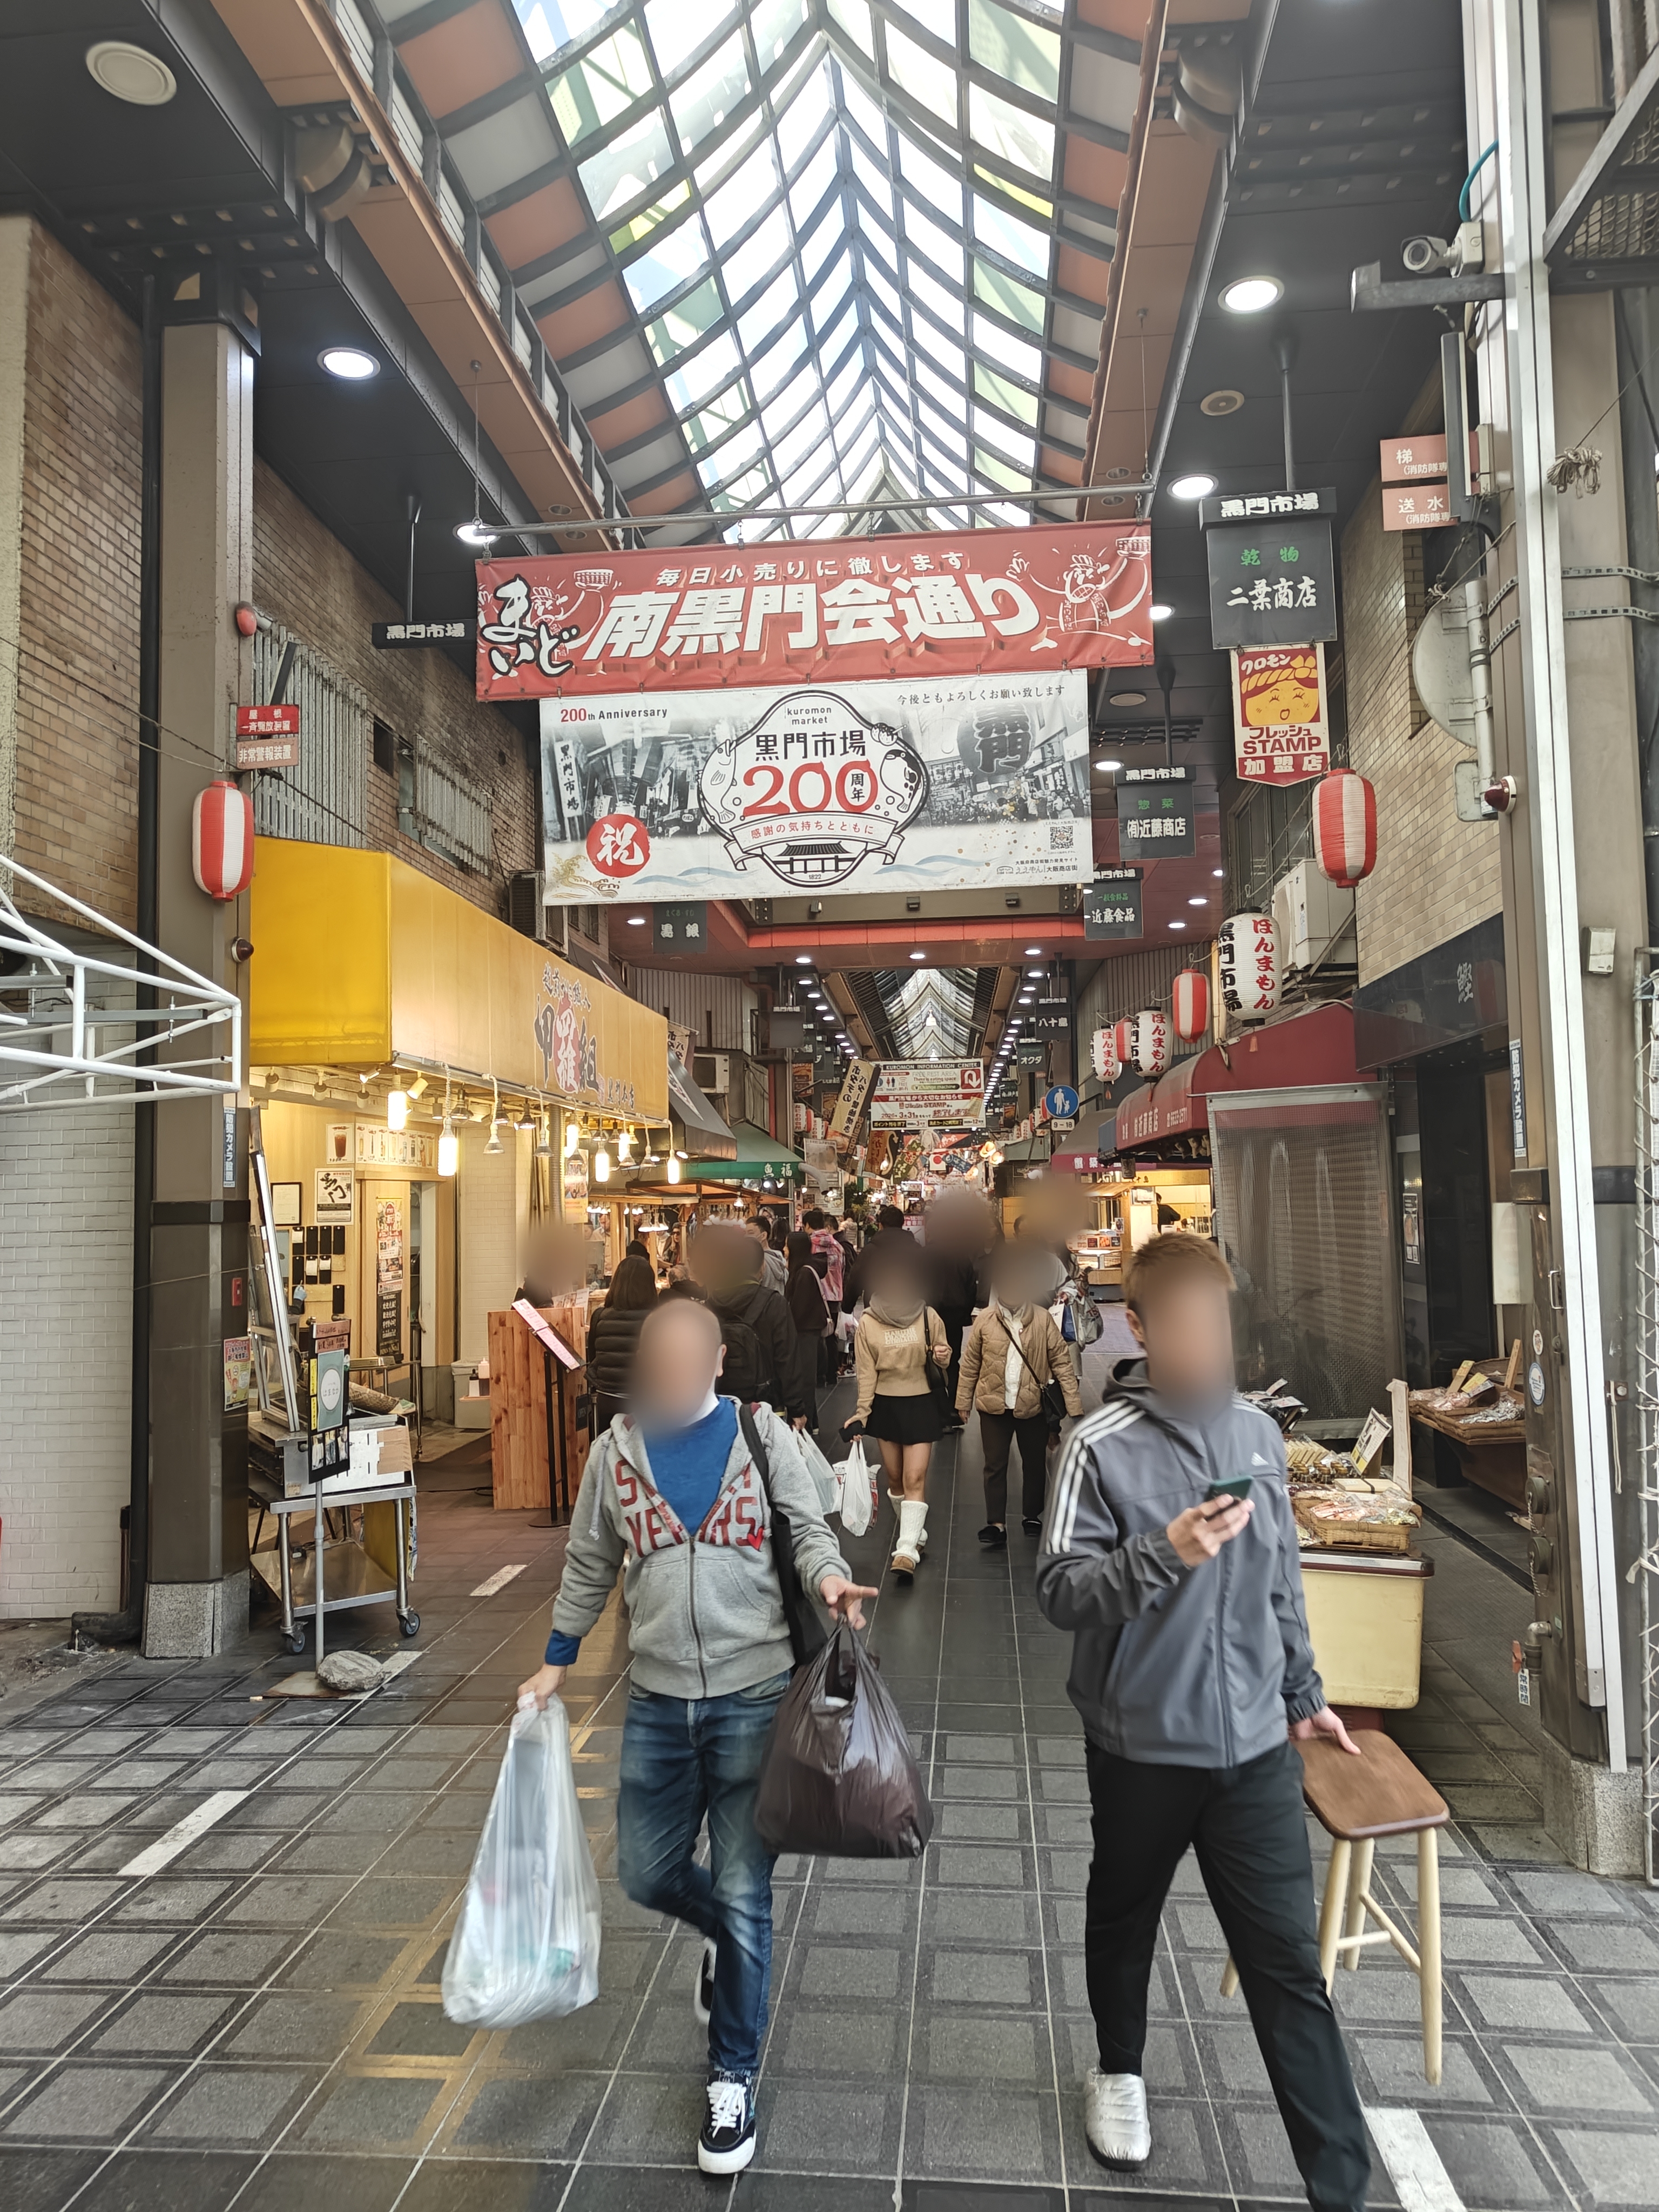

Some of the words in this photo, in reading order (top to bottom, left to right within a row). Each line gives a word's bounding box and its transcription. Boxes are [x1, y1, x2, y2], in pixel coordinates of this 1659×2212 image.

[1220, 492, 1319, 518] 黒門市場
[1240, 546, 1299, 566] 乾物
[657, 551, 964, 586] 毎日小売りに徹します
[1226, 575, 1317, 611] 二葉商店
[482, 575, 580, 677] まいど
[582, 572, 1040, 660] 南黒門会通り
[386, 623, 465, 639] 黒門市場
[1241, 653, 1291, 675] クロモン
[897, 684, 1065, 706] 今後ともよろしくお願い致します
[598, 708, 668, 720] Anniversary
[787, 706, 832, 716] kuromon
[791, 716, 828, 725] market
[1249, 725, 1312, 739] フレッシュ
[239, 745, 292, 763] 非常警報装置
[756, 729, 866, 761] 黒門市場
[1243, 737, 1321, 755] STAMP
[1125, 767, 1186, 781] 黒門市場
[1244, 754, 1323, 775] 加盟店
[743, 758, 879, 817] 200
[851, 773, 865, 802] 周年
[751, 820, 874, 839] 感謝の気持ちとともに
[596, 822, 645, 867] 祝
[1091, 907, 1135, 924] 近藤食品
[1252, 919, 1276, 1010] ほんまもん
[1102, 1032, 1114, 1076] ほんまもん
[1150, 1014, 1166, 1072] ほんまもん
[1021, 1056, 1042, 1064] オクダ
[1512, 1050, 1525, 1148] 防犯カメラ設置
[226, 1114, 234, 1181] 防犯カメラ設置
